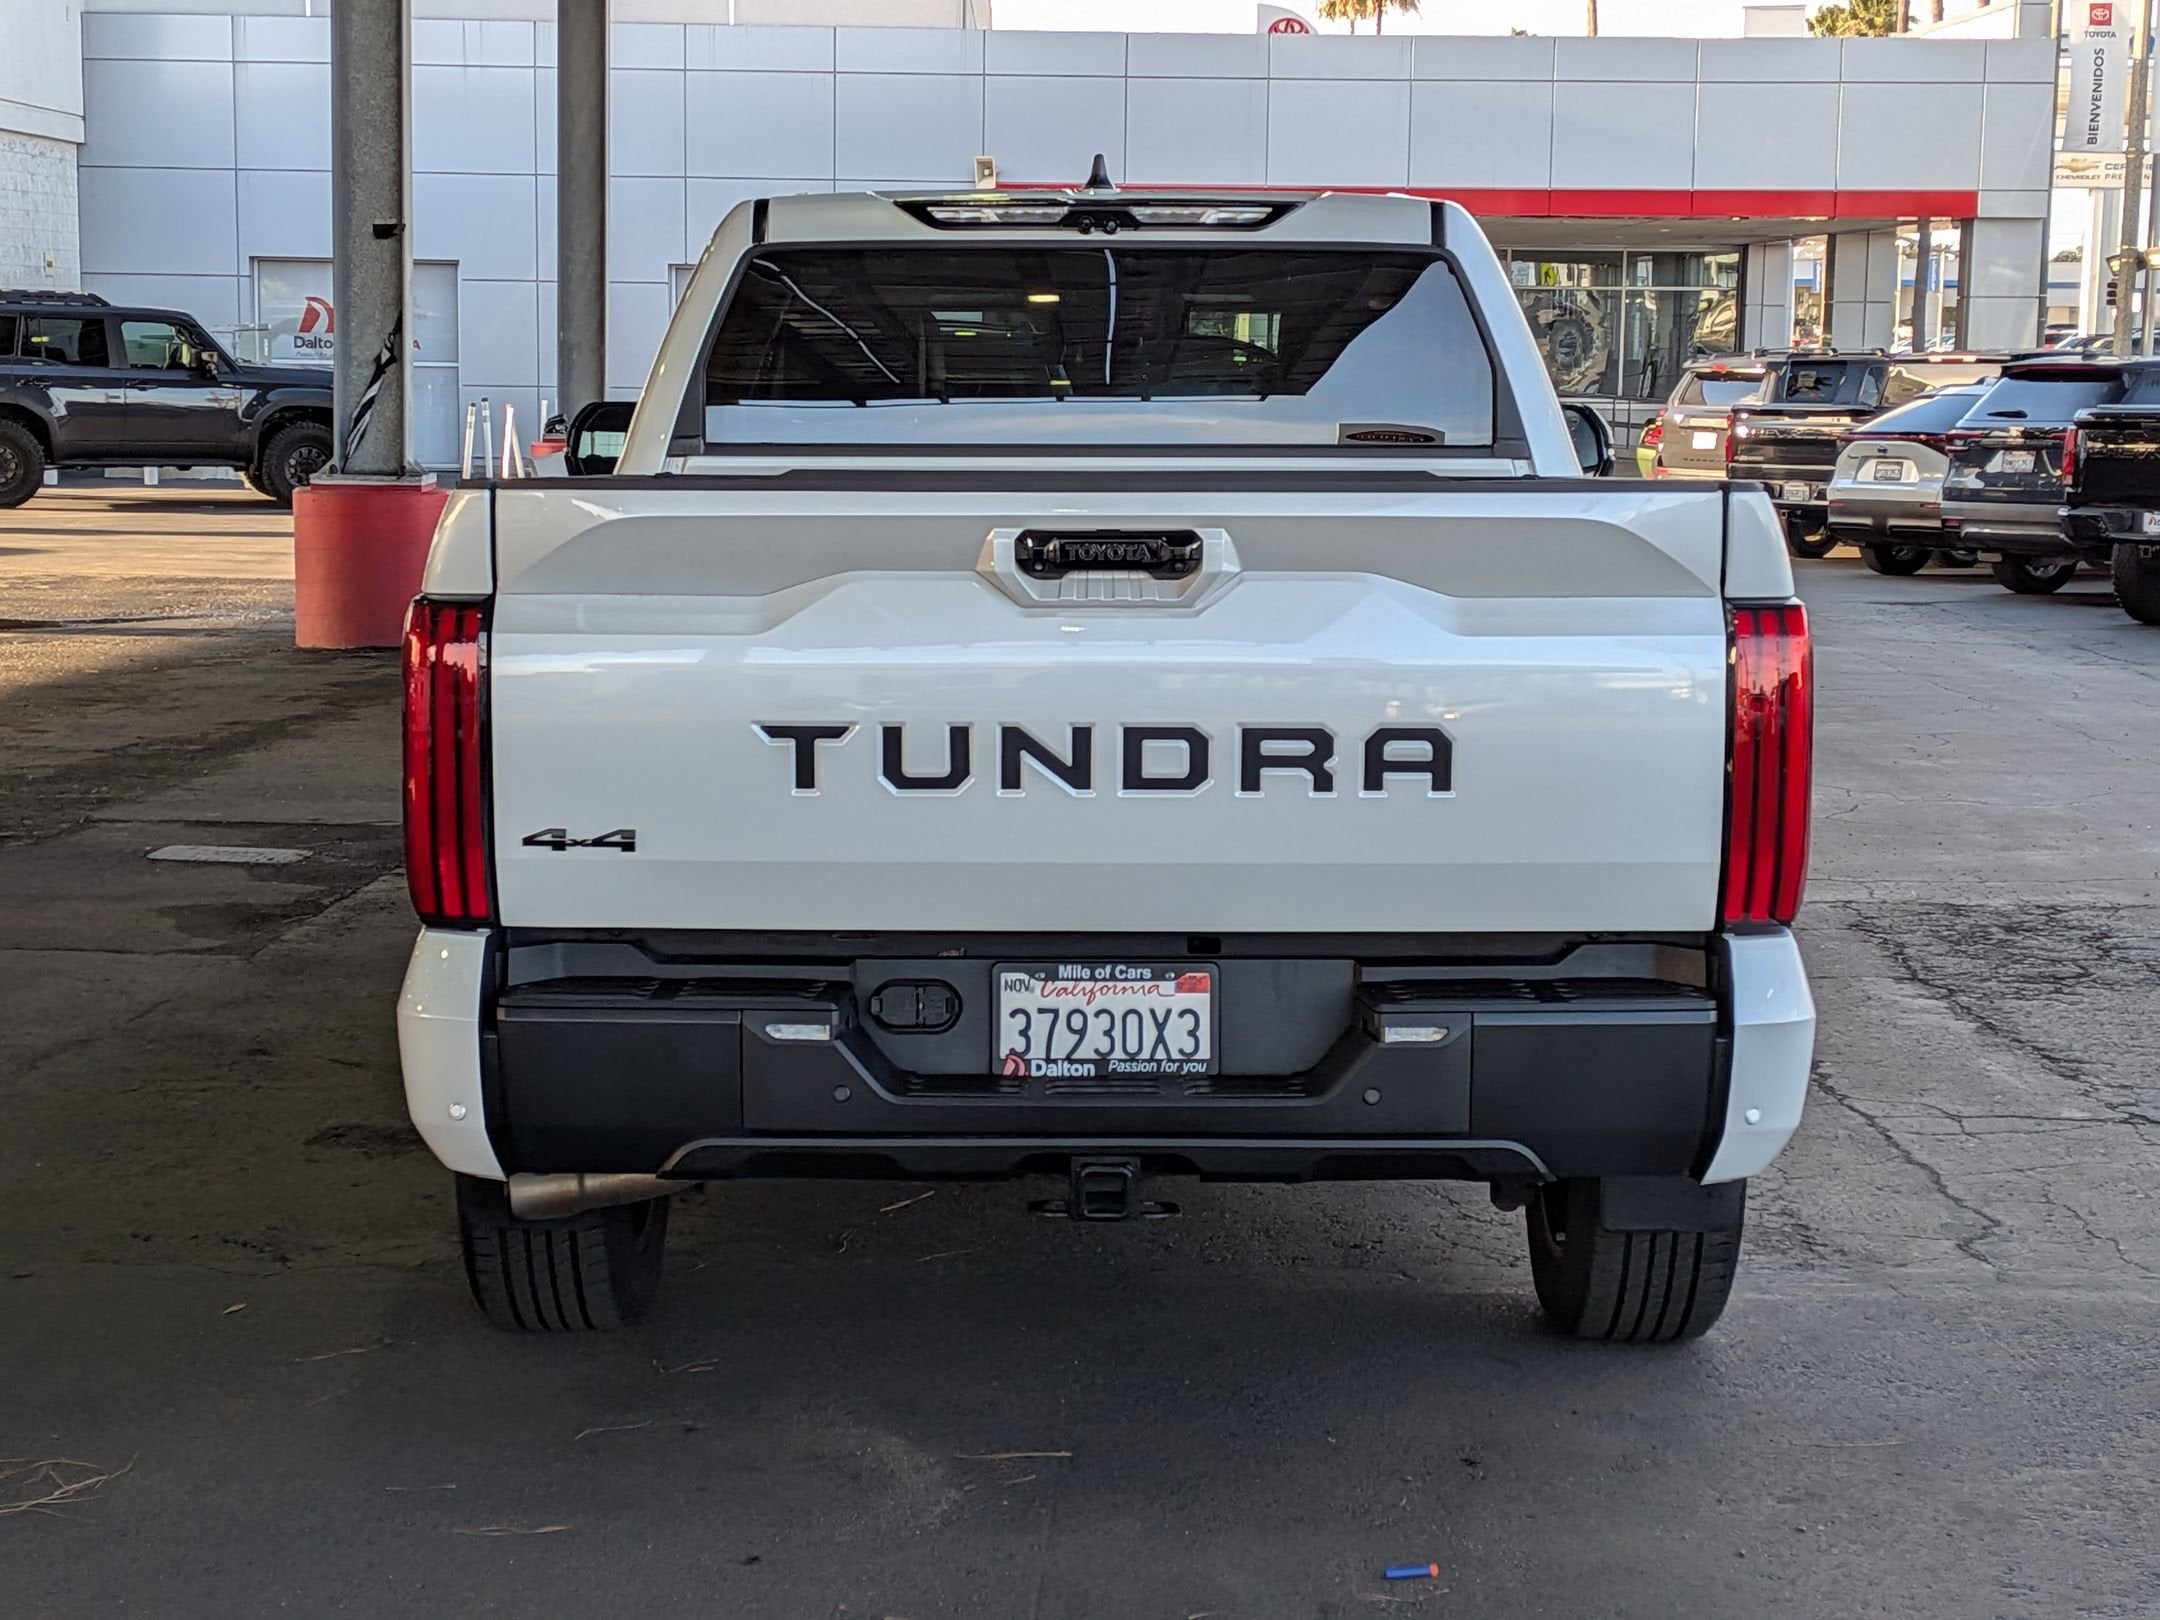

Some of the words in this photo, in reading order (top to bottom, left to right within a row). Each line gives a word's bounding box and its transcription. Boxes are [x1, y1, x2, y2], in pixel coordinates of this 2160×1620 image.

[2083, 31, 2117, 39] TOYOTA
[2087, 47, 2105, 145] BIENVENIDOS
[293, 335, 333, 349] Dalto
[1065, 543, 1150, 561] TOYOTA
[751, 721, 1457, 797] TUNDRA
[522, 828, 636, 852] 4x4
[1058, 964, 1090, 979] Mile
[1094, 964, 1112, 979] of
[1115, 964, 1152, 979] Cars
[1004, 978, 1031, 992] NOV
[1040, 979, 1176, 1006] California
[1008, 1007, 1201, 1059] 37930X3
[1031, 1059, 1096, 1077] Dalton
[1108, 1060, 1157, 1072] Passion
[1160, 1060, 1179, 1072] for
[1181, 1063, 1207, 1074] you
